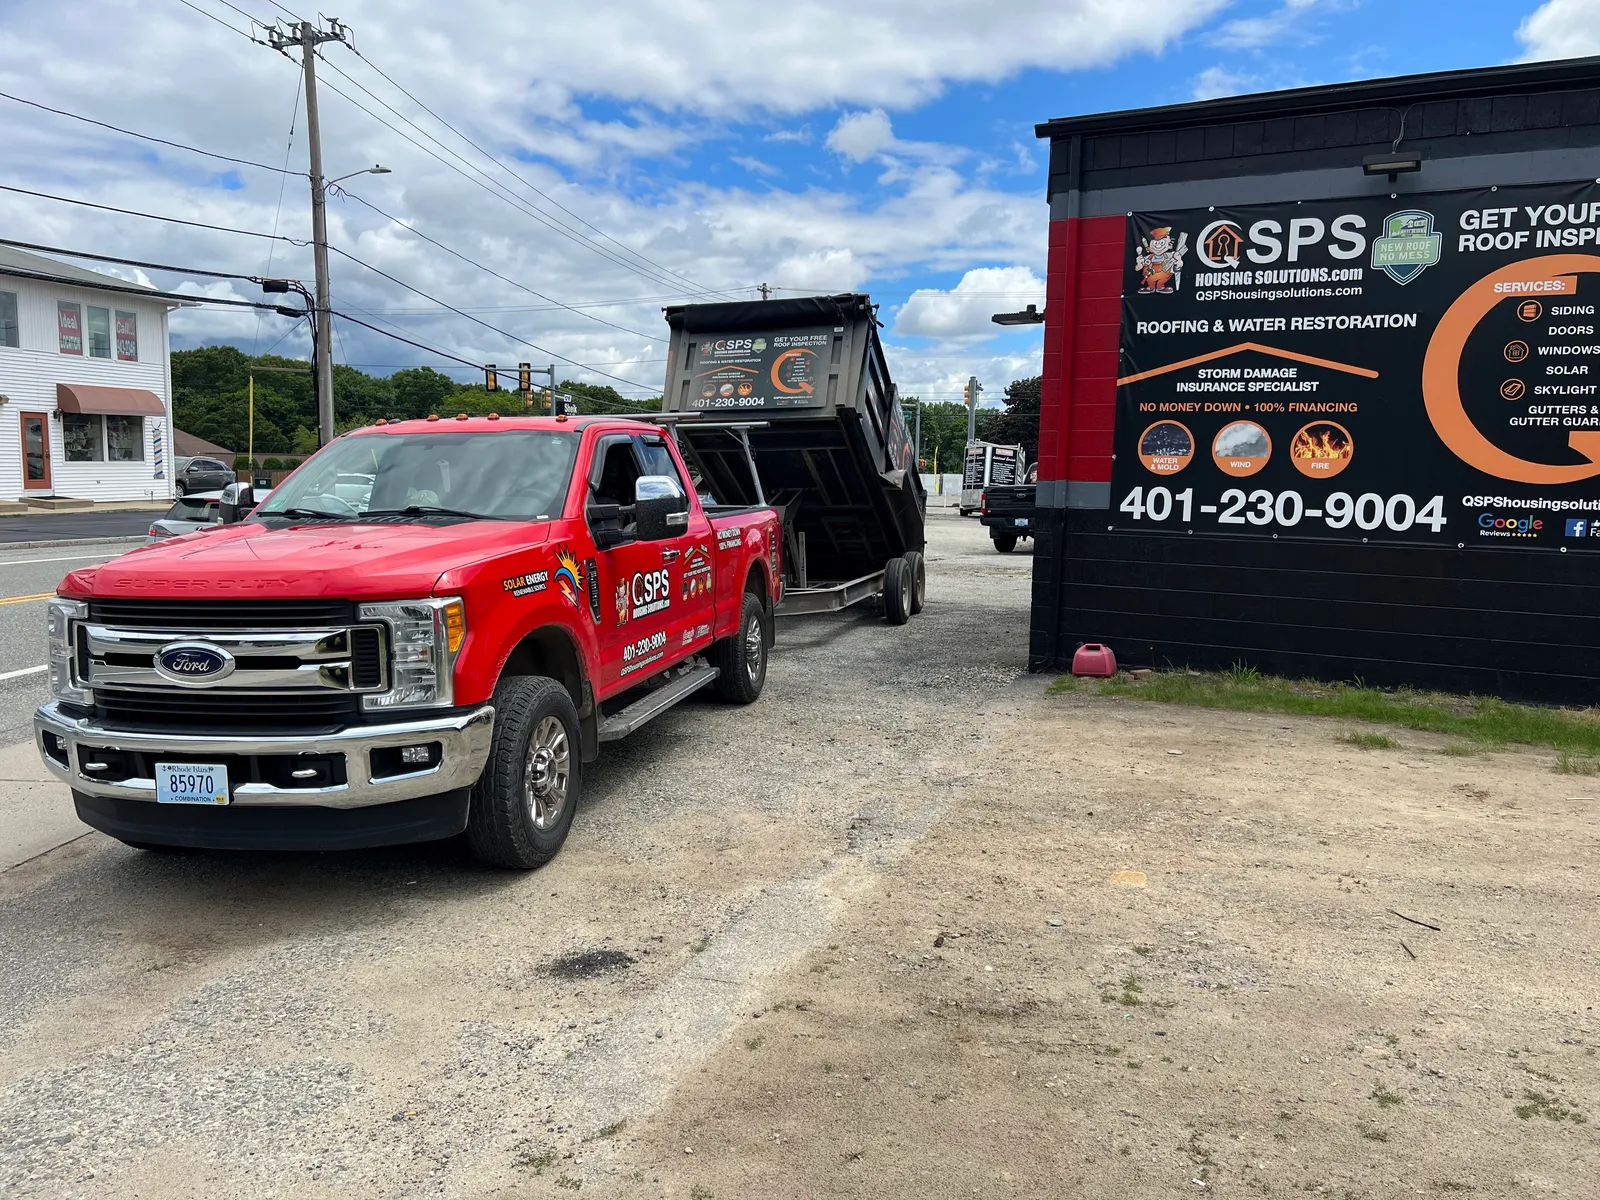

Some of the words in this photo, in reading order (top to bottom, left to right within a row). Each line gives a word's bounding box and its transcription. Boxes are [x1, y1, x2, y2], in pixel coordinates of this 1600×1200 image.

[1459, 207, 1518, 231] GET
[1458, 230, 1530, 252] ROOF
[1535, 227, 1600, 249] INSP
[1380, 242, 1403, 253] NEW
[1406, 241, 1432, 251] ROOF
[1379, 252, 1395, 261] NO
[1398, 250, 1430, 260] MESS
[1195, 271, 1253, 287] HOUSING
[1255, 267, 1363, 284] SOLUTIONS.com
[1494, 280, 1566, 293] SERVICES:
[1196, 286, 1363, 301] QSPShousingsolutions.com
[1551, 306, 1595, 316] SIDING
[1136, 319, 1209, 334] ROOFING
[1213, 319, 1225, 332] &
[1228, 317, 1286, 332] WATER
[1290, 313, 1417, 330] RESTORATION
[1548, 326, 1594, 335] DOORS
[1537, 346, 1600, 355] WINDOWS
[1198, 368, 1241, 379] STORM
[1244, 368, 1297, 379] DAMAGE
[1545, 365, 1588, 375] SOLAR
[1176, 382, 1245, 393] INSURANCE
[1248, 381, 1319, 392] SPECIALIST
[1533, 385, 1597, 395] SKYLIGHT
[692, 397, 765, 408] 401-230-9004
[1139, 402, 1156, 412] NO
[1159, 402, 1201, 412] MONEY
[1204, 402, 1242, 412] DOWN
[1254, 402, 1285, 412] 100%
[1288, 402, 1358, 413] FINANCING
[1528, 405, 1587, 415] GUTTERS
[1590, 405, 1599, 414] &
[1509, 417, 1559, 426] GUTTER
[1563, 417, 1600, 426] GUAR
[1152, 457, 1178, 465] WATER
[1311, 462, 1330, 470] FIRE
[1119, 486, 1447, 533] 401-230-9004
[1478, 513, 1544, 533] Google
[114, 579, 210, 589] SUPER
[216, 578, 301, 590] DUTY
[503, 577, 526, 591] SOLAR
[525, 570, 549, 585] ENERGY
[623, 630, 667, 662] 401-230-9004
[173, 653, 210, 672] Ford
[170, 774, 214, 794] 85970
